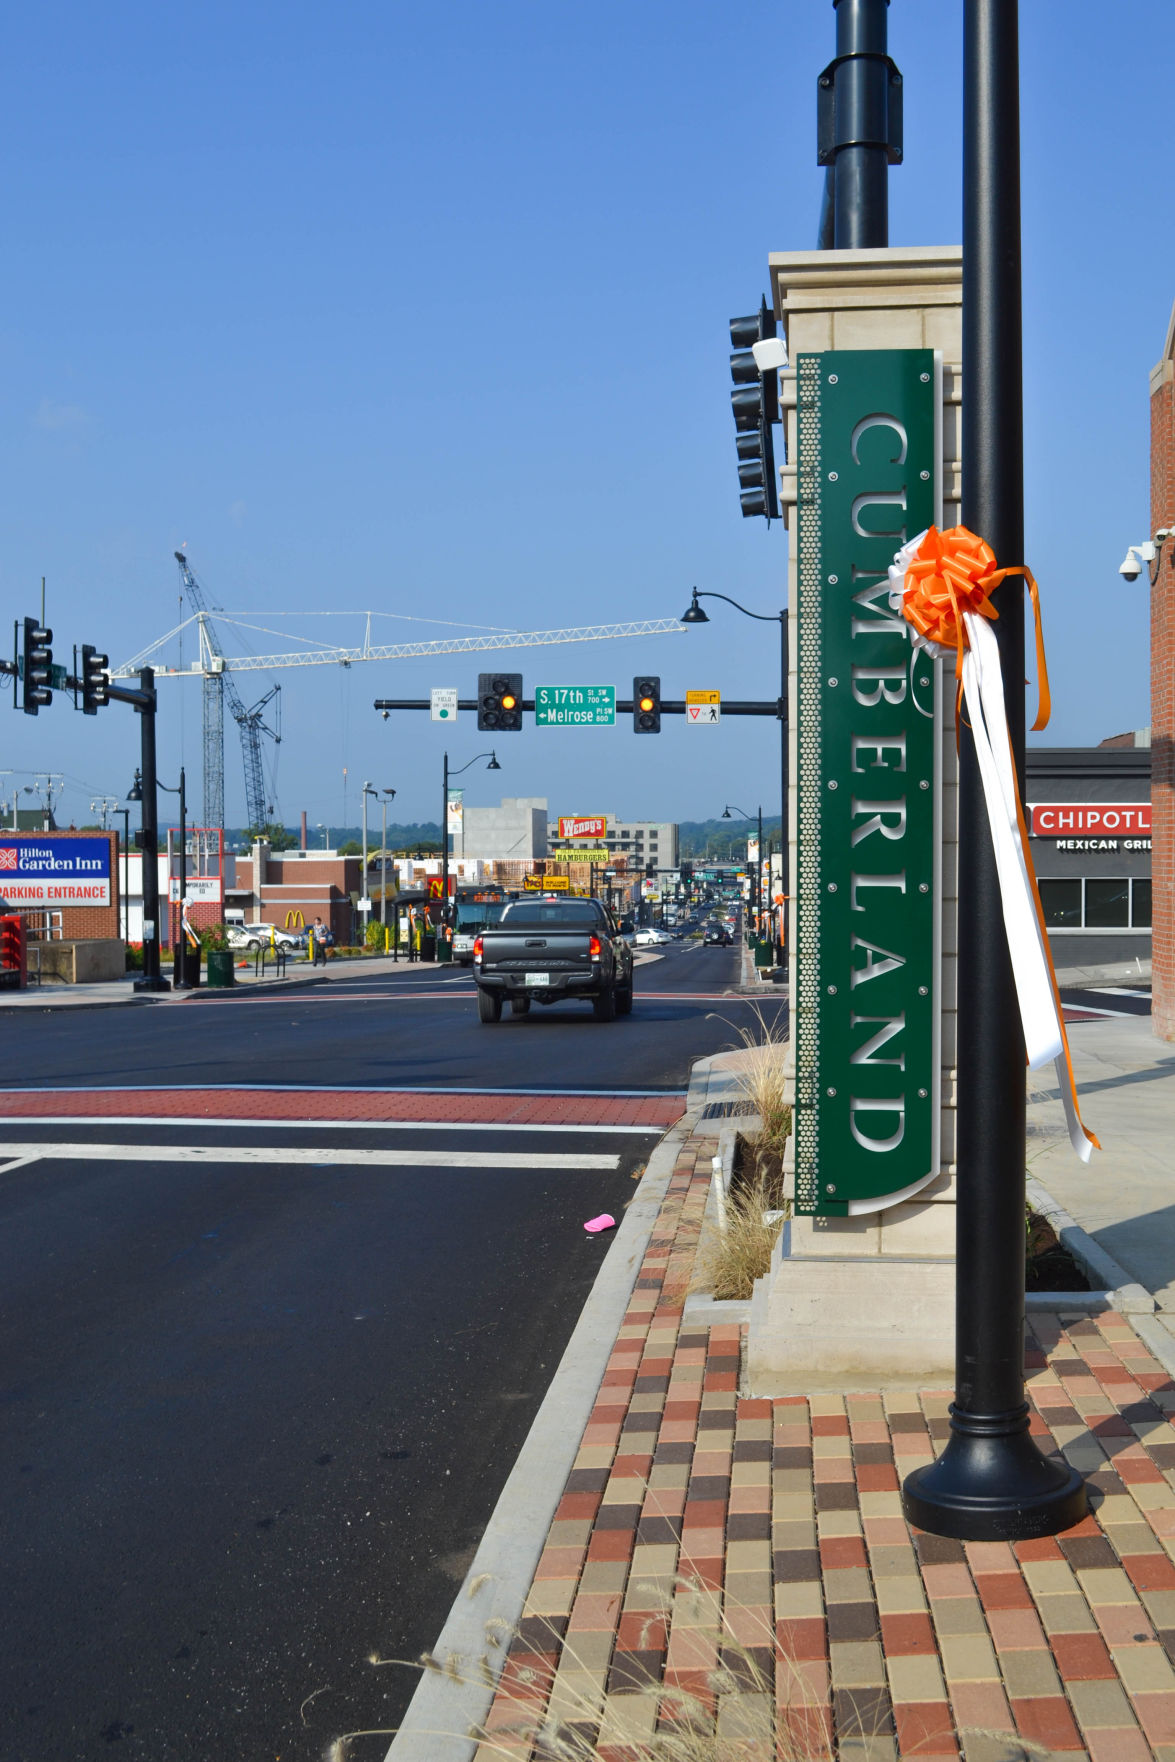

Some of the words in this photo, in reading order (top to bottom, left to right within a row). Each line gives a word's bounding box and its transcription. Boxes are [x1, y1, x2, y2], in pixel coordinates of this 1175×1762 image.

[540, 689, 551, 704] S.
[555, 689, 583, 704] 17th
[547, 708, 593, 723] Melrose
[850, 411, 908, 1153] CUMBERLAND
[1039, 811, 1151, 829] CHIPOTL
[1056, 840, 1118, 850] MEXICAN
[1123, 840, 1152, 850] GRIL
[19, 848, 53, 858] Hilton
[557, 854, 607, 862] HAMBURGERS
[19, 856, 73, 871] Garden
[75, 857, 102, 870] Inn
[47, 886, 106, 899] ENTRANCE
